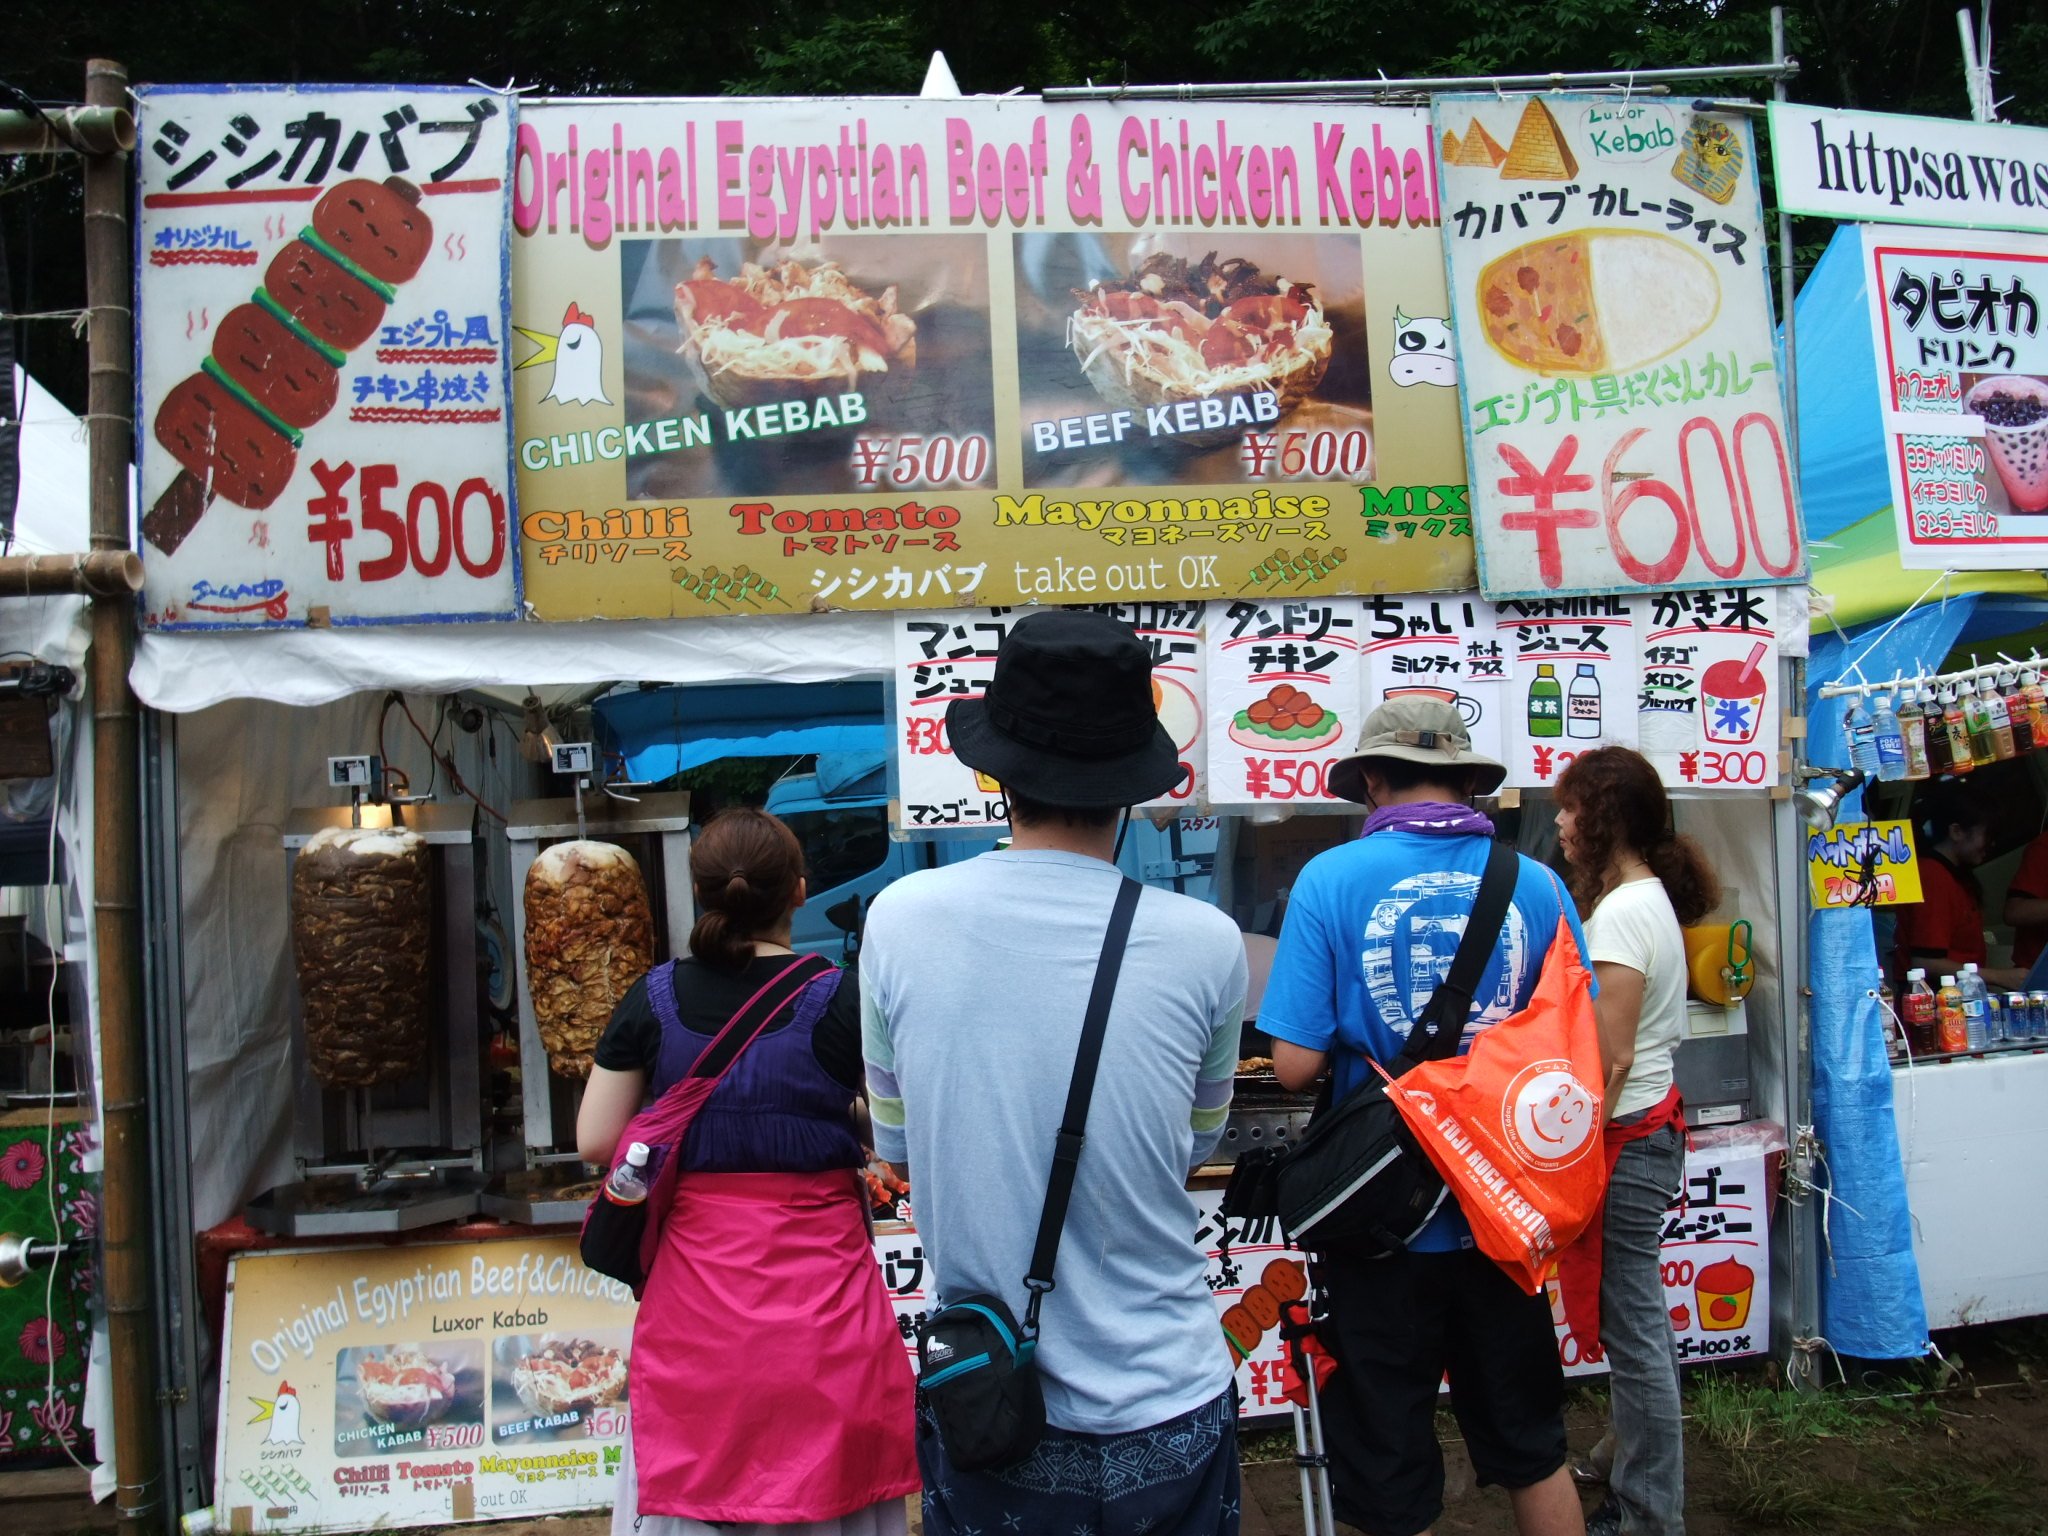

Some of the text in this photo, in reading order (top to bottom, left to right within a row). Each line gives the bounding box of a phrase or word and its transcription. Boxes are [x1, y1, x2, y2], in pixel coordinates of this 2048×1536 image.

[152, 97, 500, 191] シシカバブ
[1590, 118, 1675, 157] Kebab
[513, 122, 698, 252] Original
[715, 118, 930, 247] Egyptian
[946, 116, 1048, 229] Beef
[1066, 112, 1104, 228] &
[1117, 115, 1303, 228] Chicken
[154, 224, 253, 249] オリジナル
[1890, 267, 2040, 338] タピオカ
[379, 309, 499, 347] エジプト風
[1918, 336, 2016, 371] ドリンク
[352, 369, 490, 410] チキン串焼き
[1474, 351, 1774, 435] エジプト具だくさんカレー
[1896, 367, 1961, 402] カフェオレ
[520, 391, 869, 473] CHICKEN KEBAB
[1032, 391, 1280, 453] BEEF KEBAB
[851, 433, 989, 486] ¥500
[1241, 430, 1368, 478] ¥600
[1360, 485, 1470, 518] MIX
[1496, 411, 1801, 590] ¥600
[1912, 480, 1987, 504] イチゴミルク
[307, 458, 506, 582] ¥500
[522, 508, 693, 543] Chilli
[729, 501, 961, 536] Tomato
[993, 490, 1330, 532] Mayonnaise
[1917, 510, 1999, 538] マンゴーミルク
[1100, 521, 1331, 547] マヨネーズソース
[1365, 518, 1473, 540] ミックス
[540, 542, 693, 566] チリソース
[782, 533, 962, 559] トマトソース
[809, 561, 988, 600] シシカバブ
[1014, 555, 1221, 596] take out OK
[1226, 602, 1353, 642] タンドリー
[1363, 594, 1474, 639] ちゃい
[1467, 640, 1502, 657] ホット
[1517, 625, 1609, 652] ジュース
[1249, 643, 1339, 673] チキン
[1392, 654, 1460, 673] ミルクティ
[1469, 660, 1503, 674] アイス
[1644, 646, 1698, 665] イチゴ
[1643, 673, 1695, 690] メロン
[1638, 691, 1698, 713] ブルーハワイ
[1714, 699, 1751, 734] 氷
[1680, 750, 1767, 784] ¥300
[1505, 1105, 1513, 1127] happy
[1436, 1115, 1474, 1156] FUJI
[1465, 1149, 1510, 1196] ROCK
[1500, 1187, 1555, 1261] FESTIV
[1658, 1211, 1753, 1246] ムージー
[250, 1285, 350, 1375] Original
[353, 1264, 462, 1329] Egyptian
[432, 1307, 548, 1333] Luxor Kabab
[338, 1423, 395, 1443] CHICKEN
[377, 1431, 422, 1449] KABAB
[427, 1423, 483, 1449] ¥500
[499, 1411, 580, 1437] BEEF KABAB
[334, 1464, 390, 1484] Chilli
[396, 1460, 475, 1480] Tomato
[480, 1449, 599, 1476] Mayonnaise
[516, 1465, 599, 1484] マヨネーズソース
[339, 1483, 390, 1498] チリソース
[480, 1492, 505, 1507] out
[510, 1489, 528, 1504] OK
